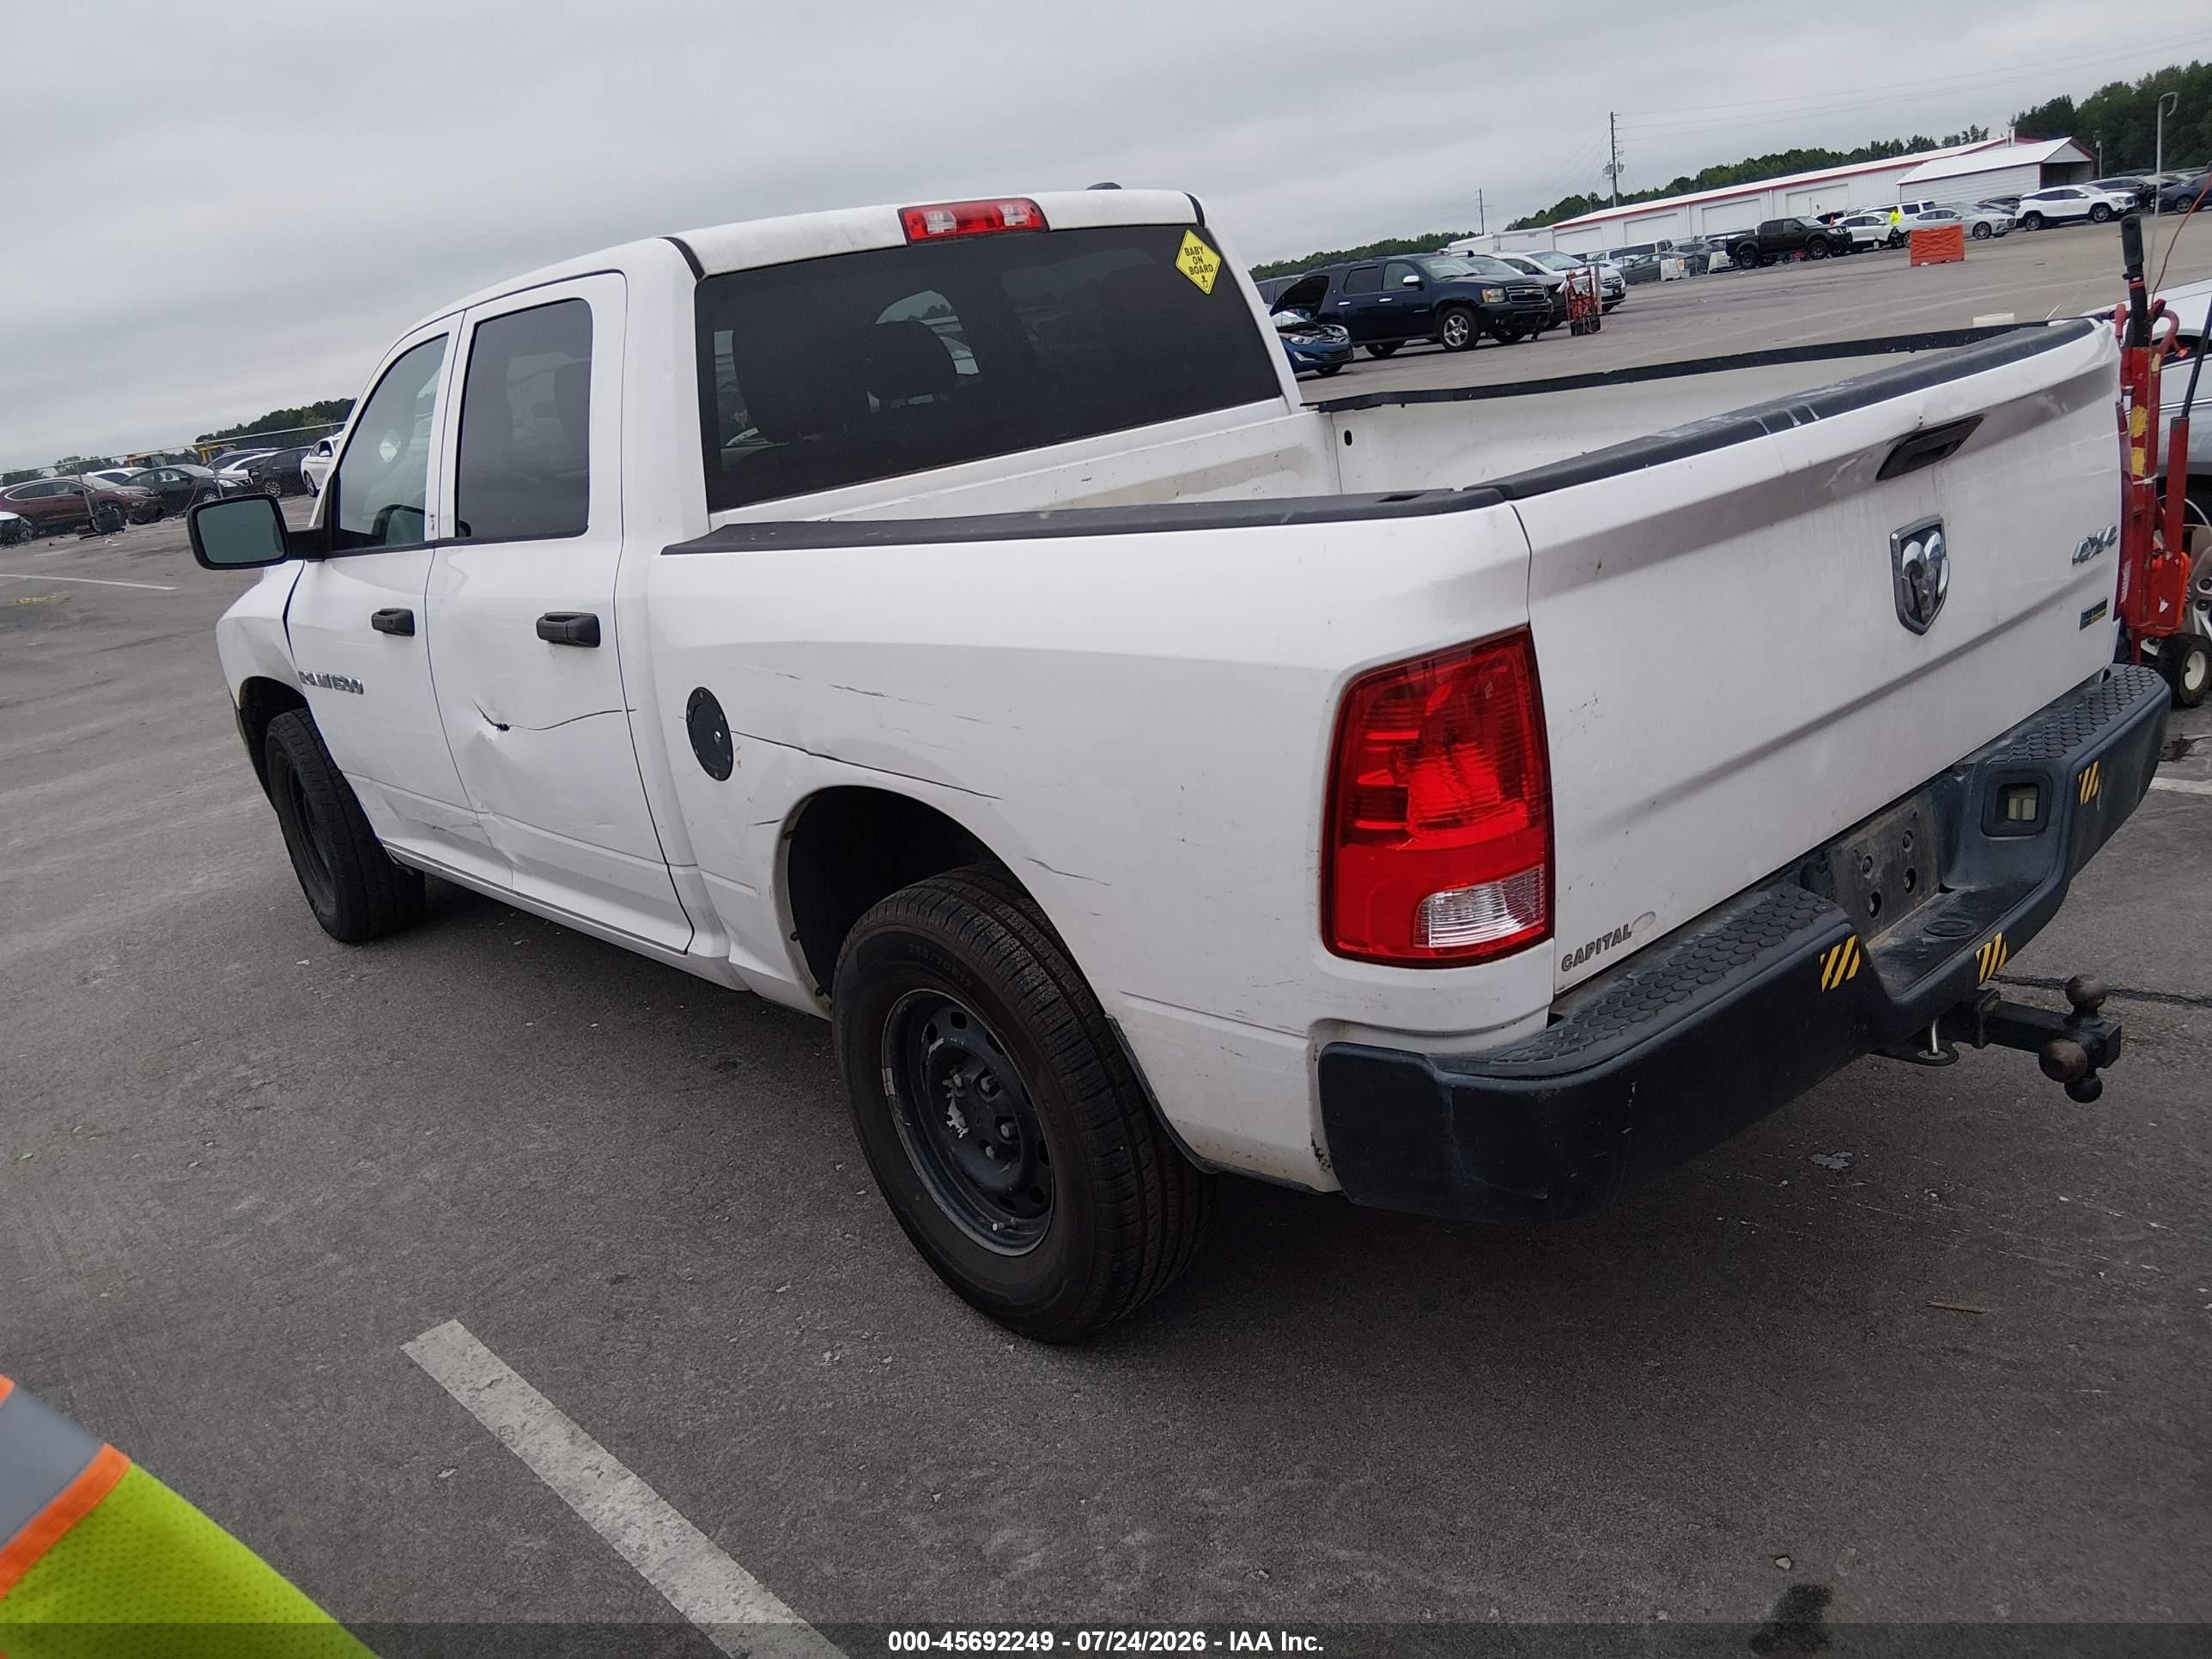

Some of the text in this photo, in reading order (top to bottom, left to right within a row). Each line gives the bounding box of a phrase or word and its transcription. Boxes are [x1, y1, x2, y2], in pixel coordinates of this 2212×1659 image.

[1184, 246, 1204, 257] BABY
[1192, 255, 1204, 265] ON
[1188, 264, 1214, 276] BOARD
[1561, 923, 1632, 973] CAPITAL
